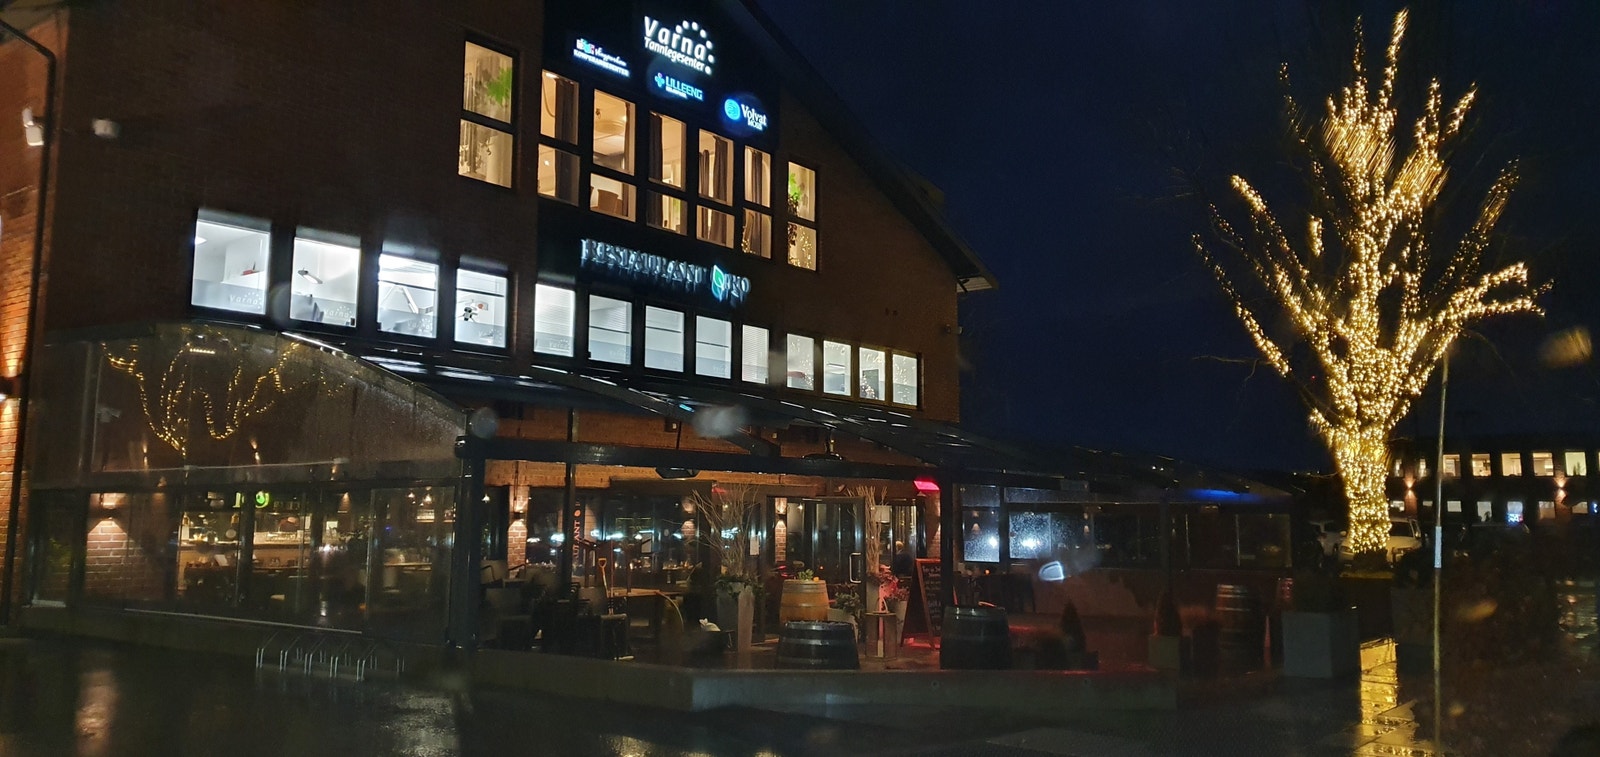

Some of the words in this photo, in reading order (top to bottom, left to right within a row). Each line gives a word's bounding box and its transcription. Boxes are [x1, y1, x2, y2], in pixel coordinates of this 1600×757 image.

[644, 16, 706, 61] Varna
[644, 36, 705, 72] Tannlegesenter
[666, 76, 703, 101] LILLEENG
[741, 104, 767, 127] Volvat
[580, 238, 707, 284] RESTAURANT
